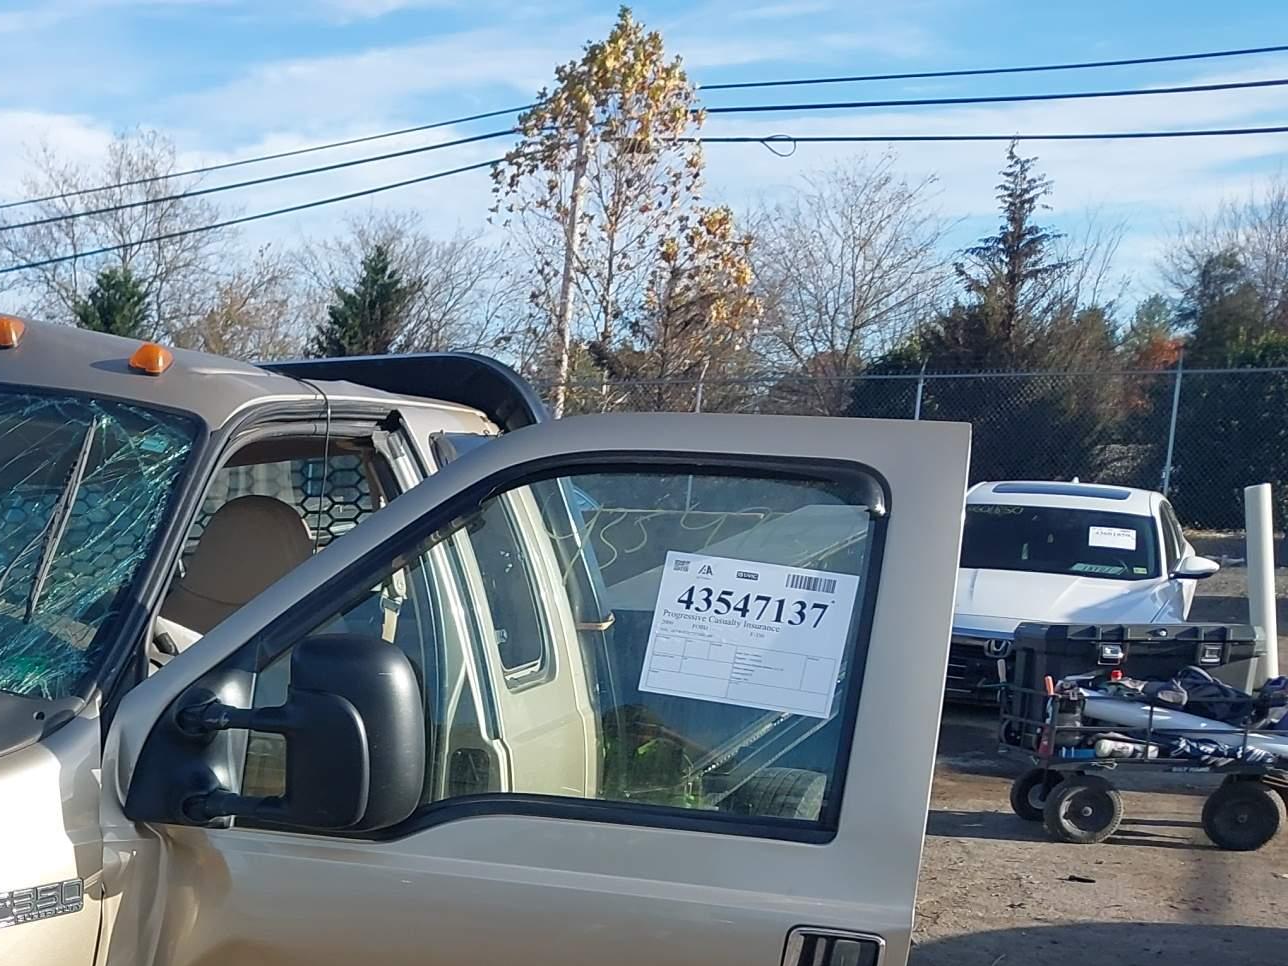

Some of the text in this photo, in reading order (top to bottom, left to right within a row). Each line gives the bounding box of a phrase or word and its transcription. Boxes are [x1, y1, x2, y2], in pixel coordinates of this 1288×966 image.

[663, 609, 781, 633] Progressive Casualty Insurance
[677, 585, 829, 629] 43547137
